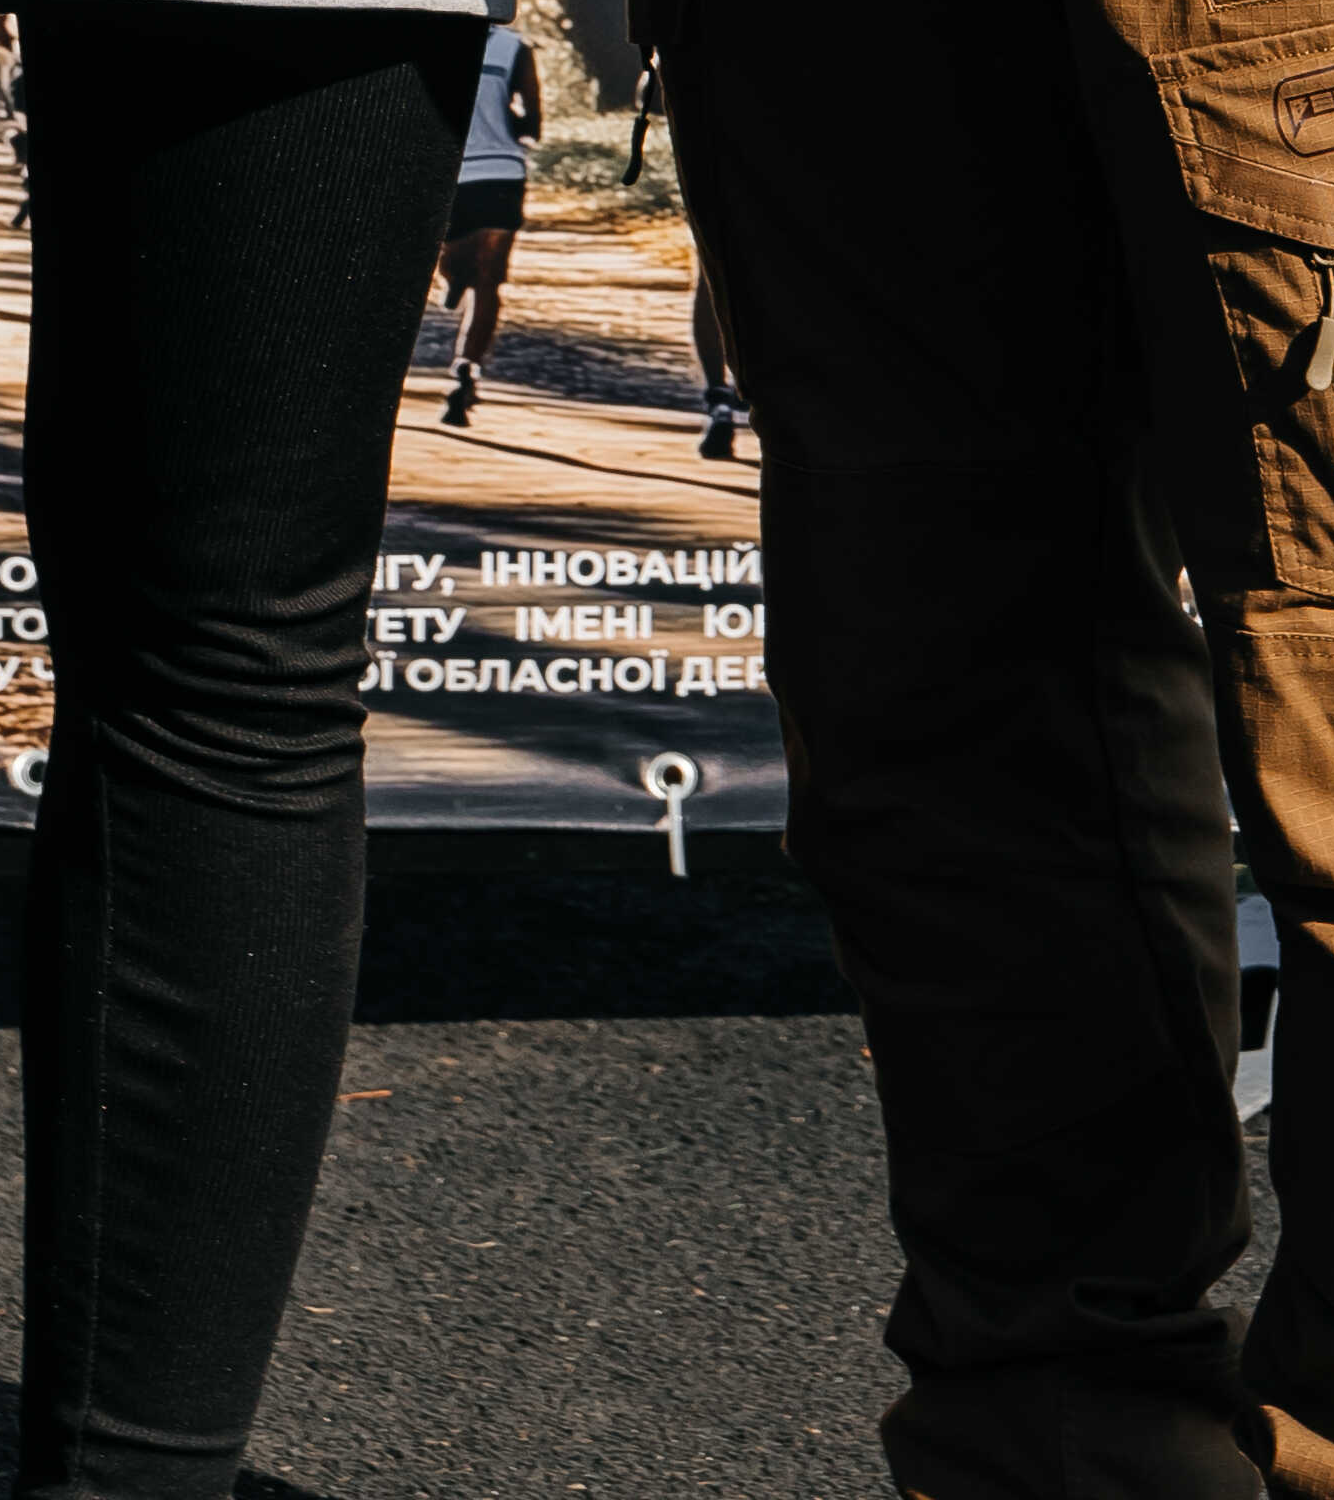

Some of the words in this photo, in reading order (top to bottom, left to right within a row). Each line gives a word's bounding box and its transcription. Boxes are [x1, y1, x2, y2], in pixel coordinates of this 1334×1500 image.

[480, 542, 762, 592] ІННОВАЦІЙ
[514, 604, 654, 642] ІМЕНІ
[405, 649, 670, 693] ОБЛАСНОЇ
